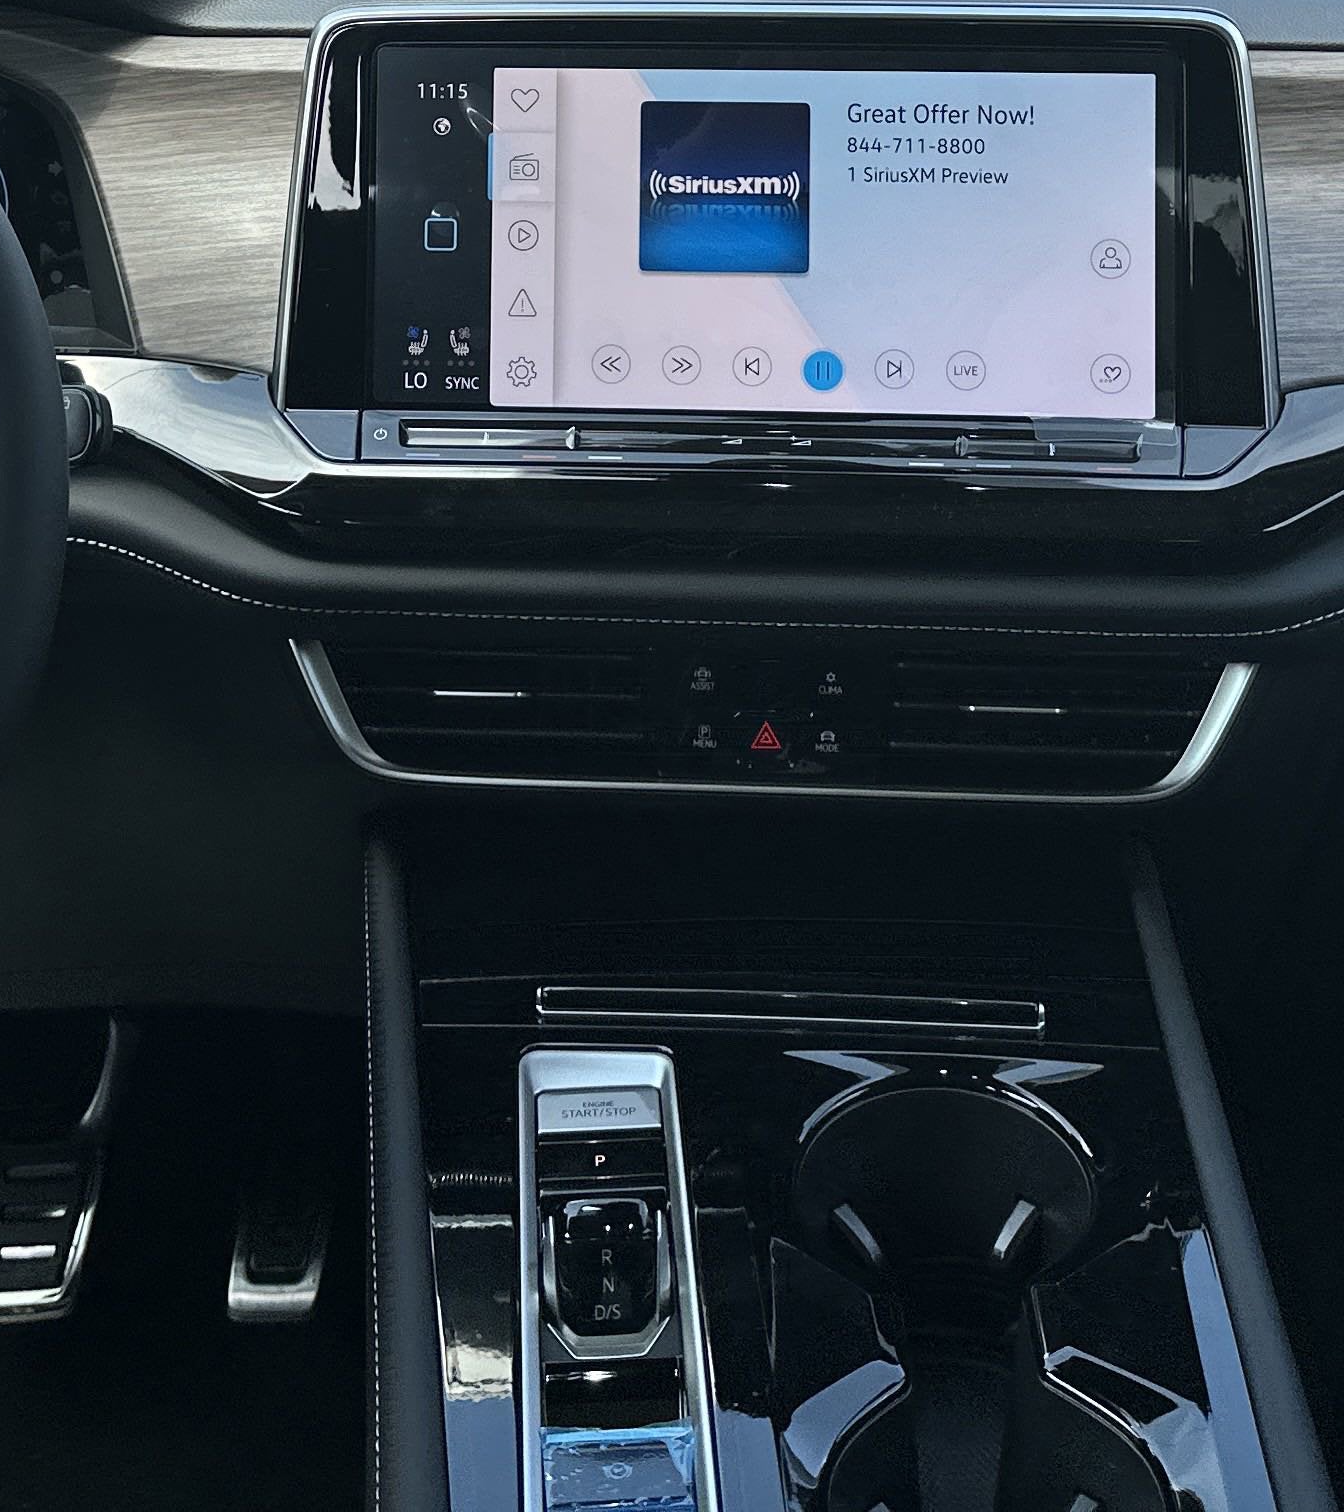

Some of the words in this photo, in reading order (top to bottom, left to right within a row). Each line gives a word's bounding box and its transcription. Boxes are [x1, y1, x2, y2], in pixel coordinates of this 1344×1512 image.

[417, 83, 468, 99] 11:15
[847, 102, 907, 125] Great
[913, 103, 970, 125] Offer
[977, 104, 1036, 126] Now!
[847, 137, 986, 155] 844-711-8800
[848, 167, 856, 182] 1
[863, 166, 937, 184] SiriusXM
[942, 167, 1010, 184] Preview
[953, 365, 978, 377] LIVE
[404, 371, 428, 389] LO
[445, 376, 481, 390] SYNC
[690, 681, 715, 691] ASSIST
[818, 685, 843, 695] CLIMA
[693, 739, 717, 749] MENU
[815, 743, 840, 753] MODE
[561, 1105, 637, 1119] START/STOP
[594, 1155, 606, 1167] P
[601, 1250, 613, 1266] R
[602, 1278, 615, 1293] N
[594, 1304, 622, 1321] D/S
